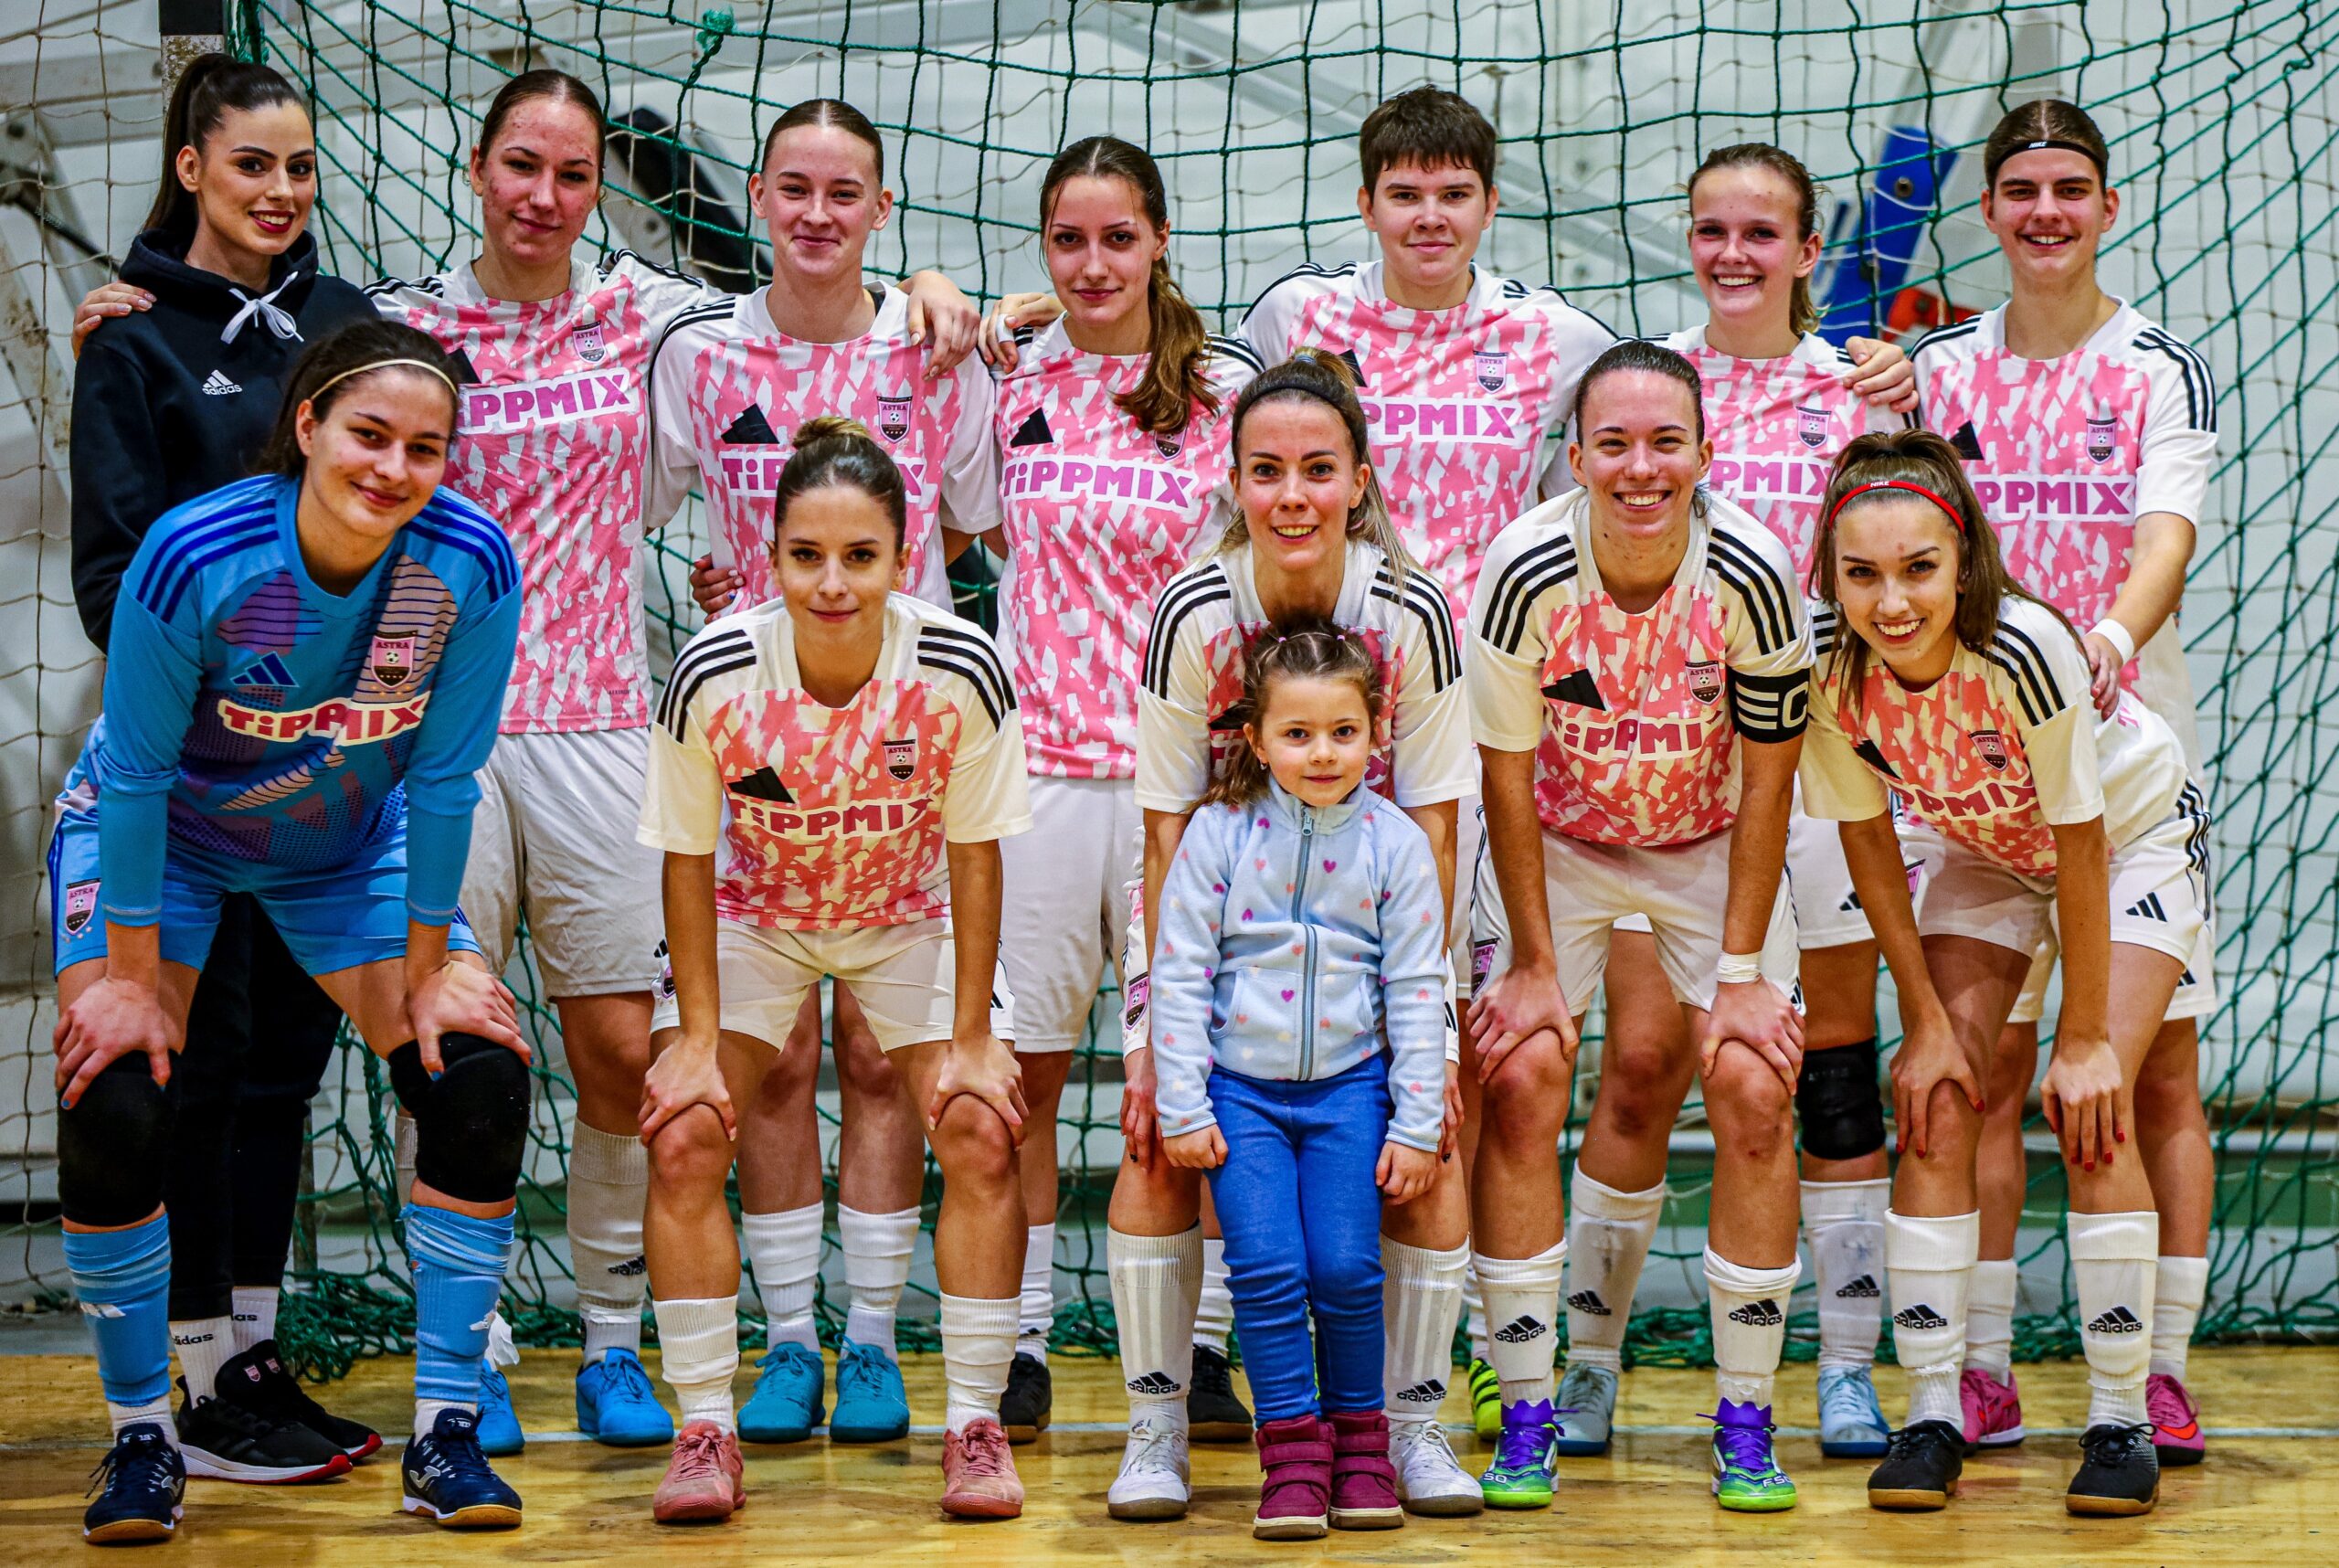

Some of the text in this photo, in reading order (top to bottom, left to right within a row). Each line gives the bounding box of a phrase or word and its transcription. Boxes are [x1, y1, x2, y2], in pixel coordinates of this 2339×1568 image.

[202, 384, 243, 395] adidas
[455, 375, 630, 427] PPMIX
[1360, 403, 1517, 439] PPMIX
[722, 459, 925, 496] TiPX
[1709, 460, 1831, 496] PMIX
[1974, 482, 2131, 514] PPMIX
[1551, 710, 1724, 756] iPPMI
[608, 1265, 646, 1277] adid
[1728, 1309, 1783, 1327] adidas
[1894, 1316, 1947, 1330] adidas
[2089, 1322, 2143, 1333] adidas
[1494, 1324, 1547, 1343] adidas
[1127, 1382, 1180, 1394] adidas
